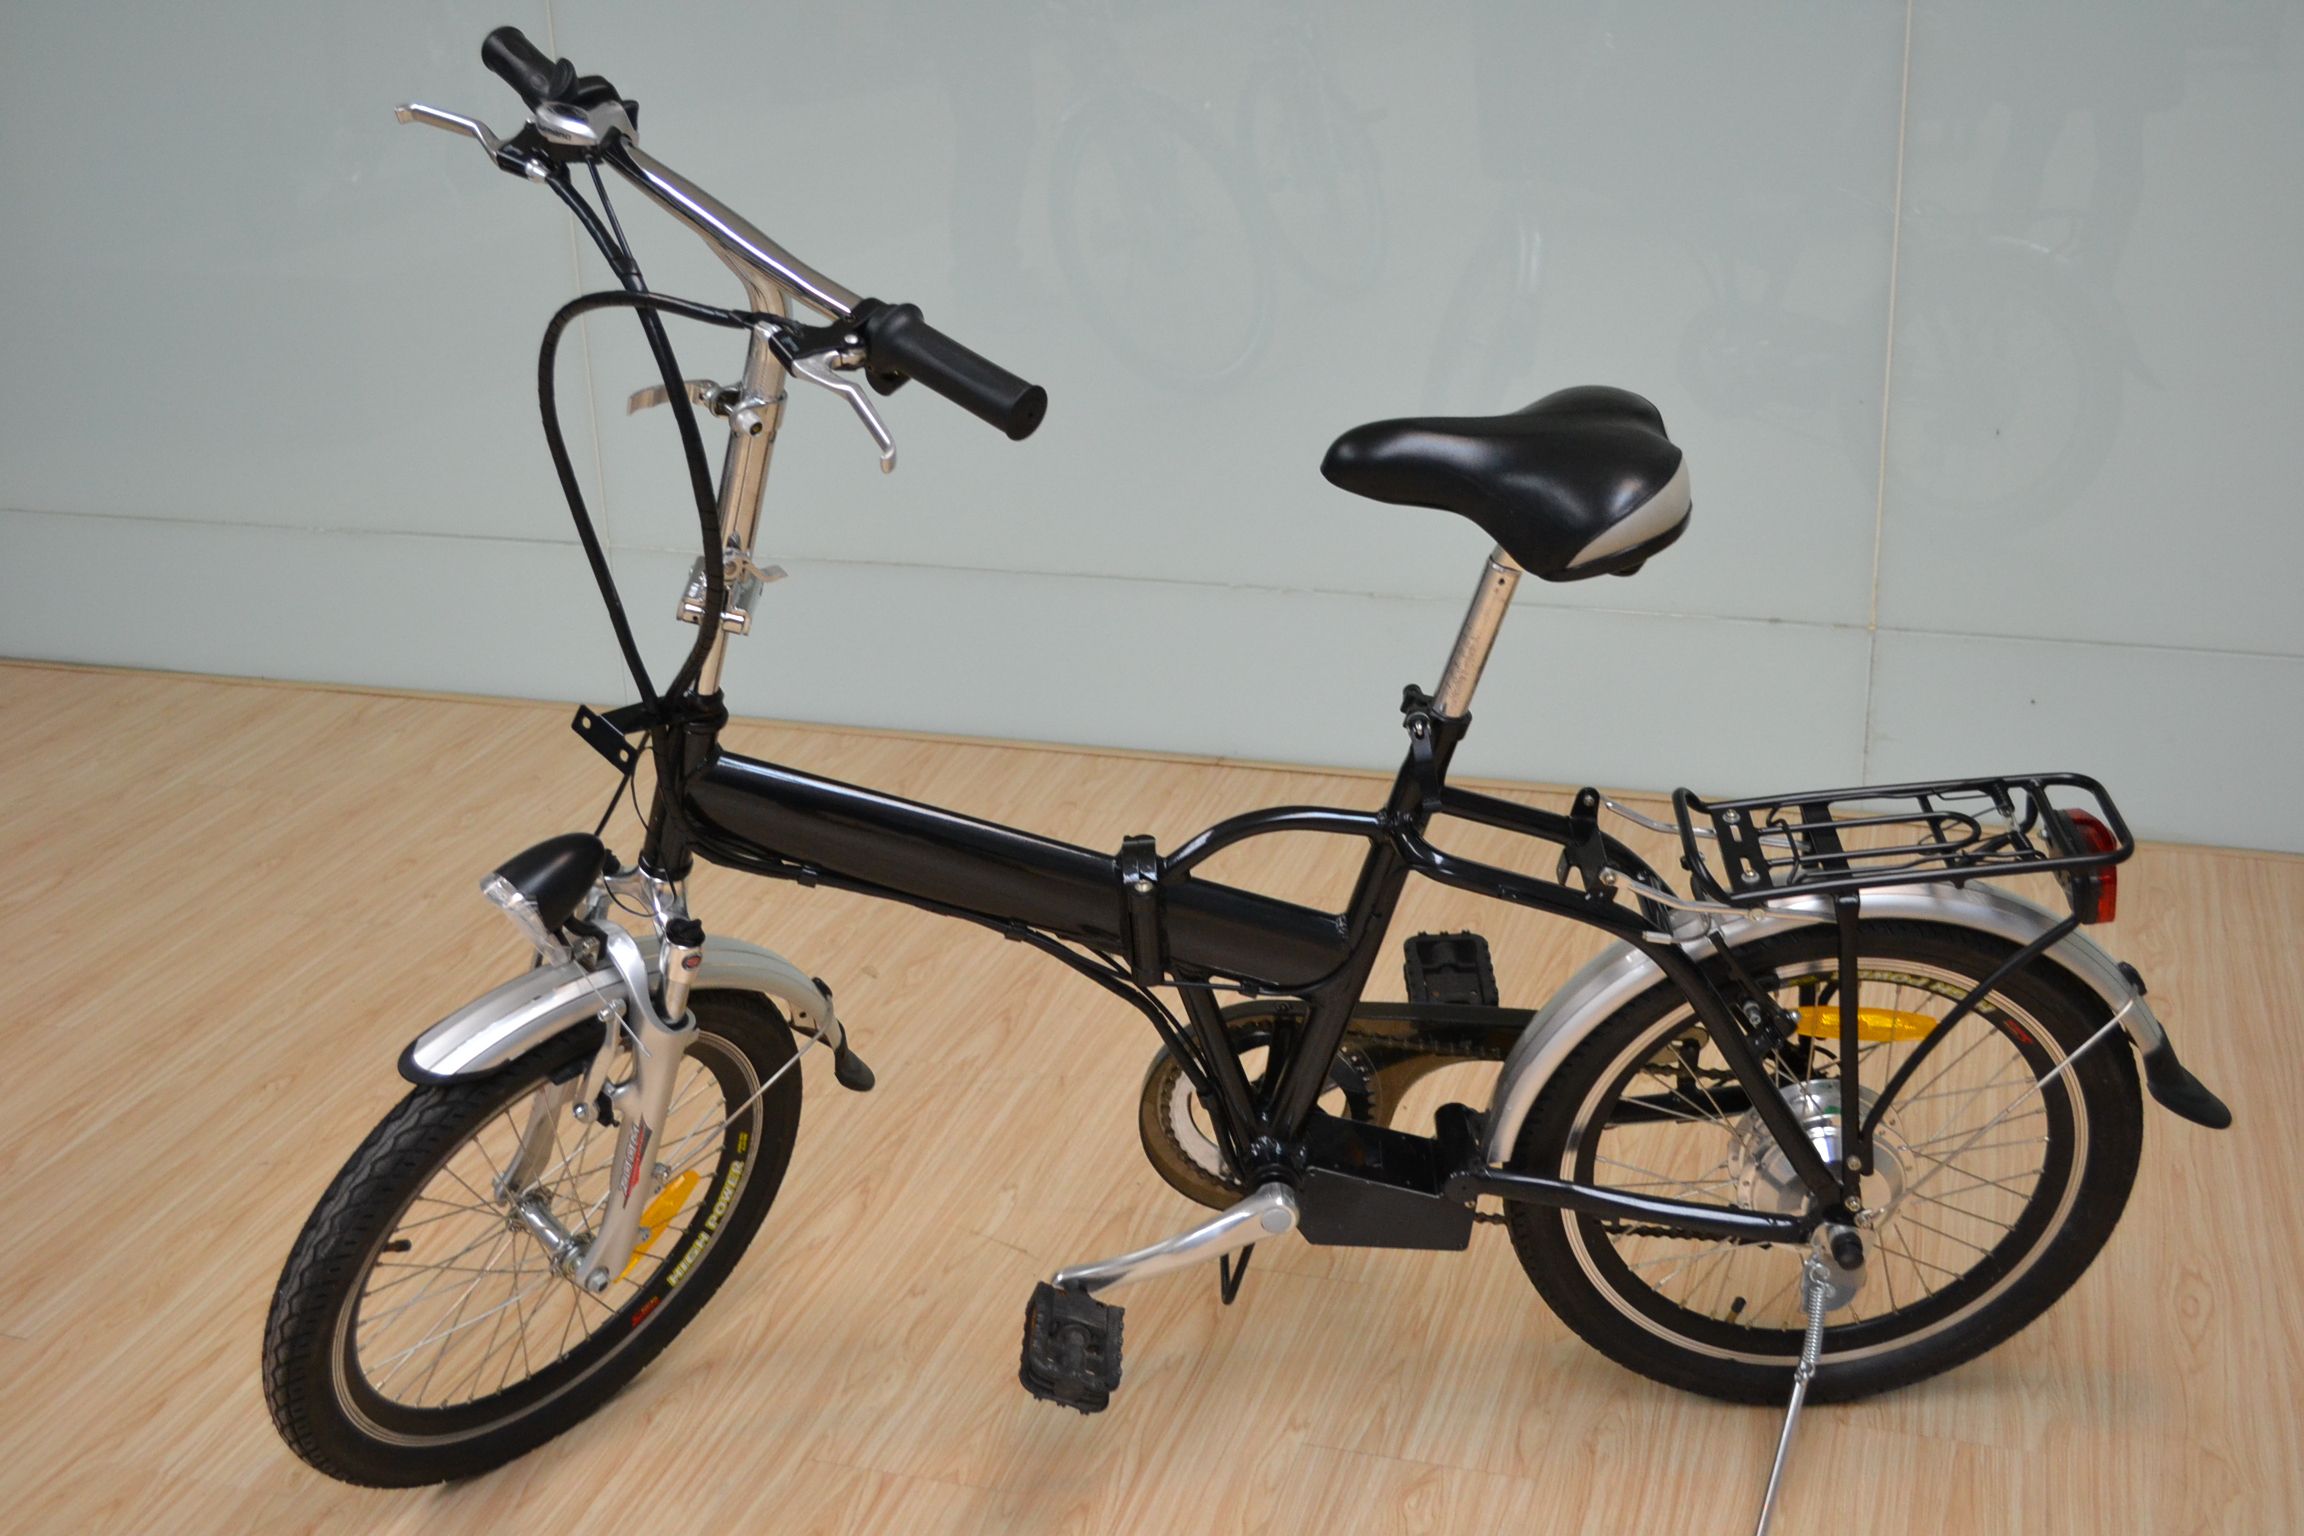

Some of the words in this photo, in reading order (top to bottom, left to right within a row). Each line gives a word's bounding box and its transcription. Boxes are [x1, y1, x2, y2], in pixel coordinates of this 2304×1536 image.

[1928, 981, 1997, 1014] HGH
[618, 1120, 641, 1197] ZOOM
[667, 1230, 711, 1287] HIGH
[705, 1160, 745, 1231] POWER
